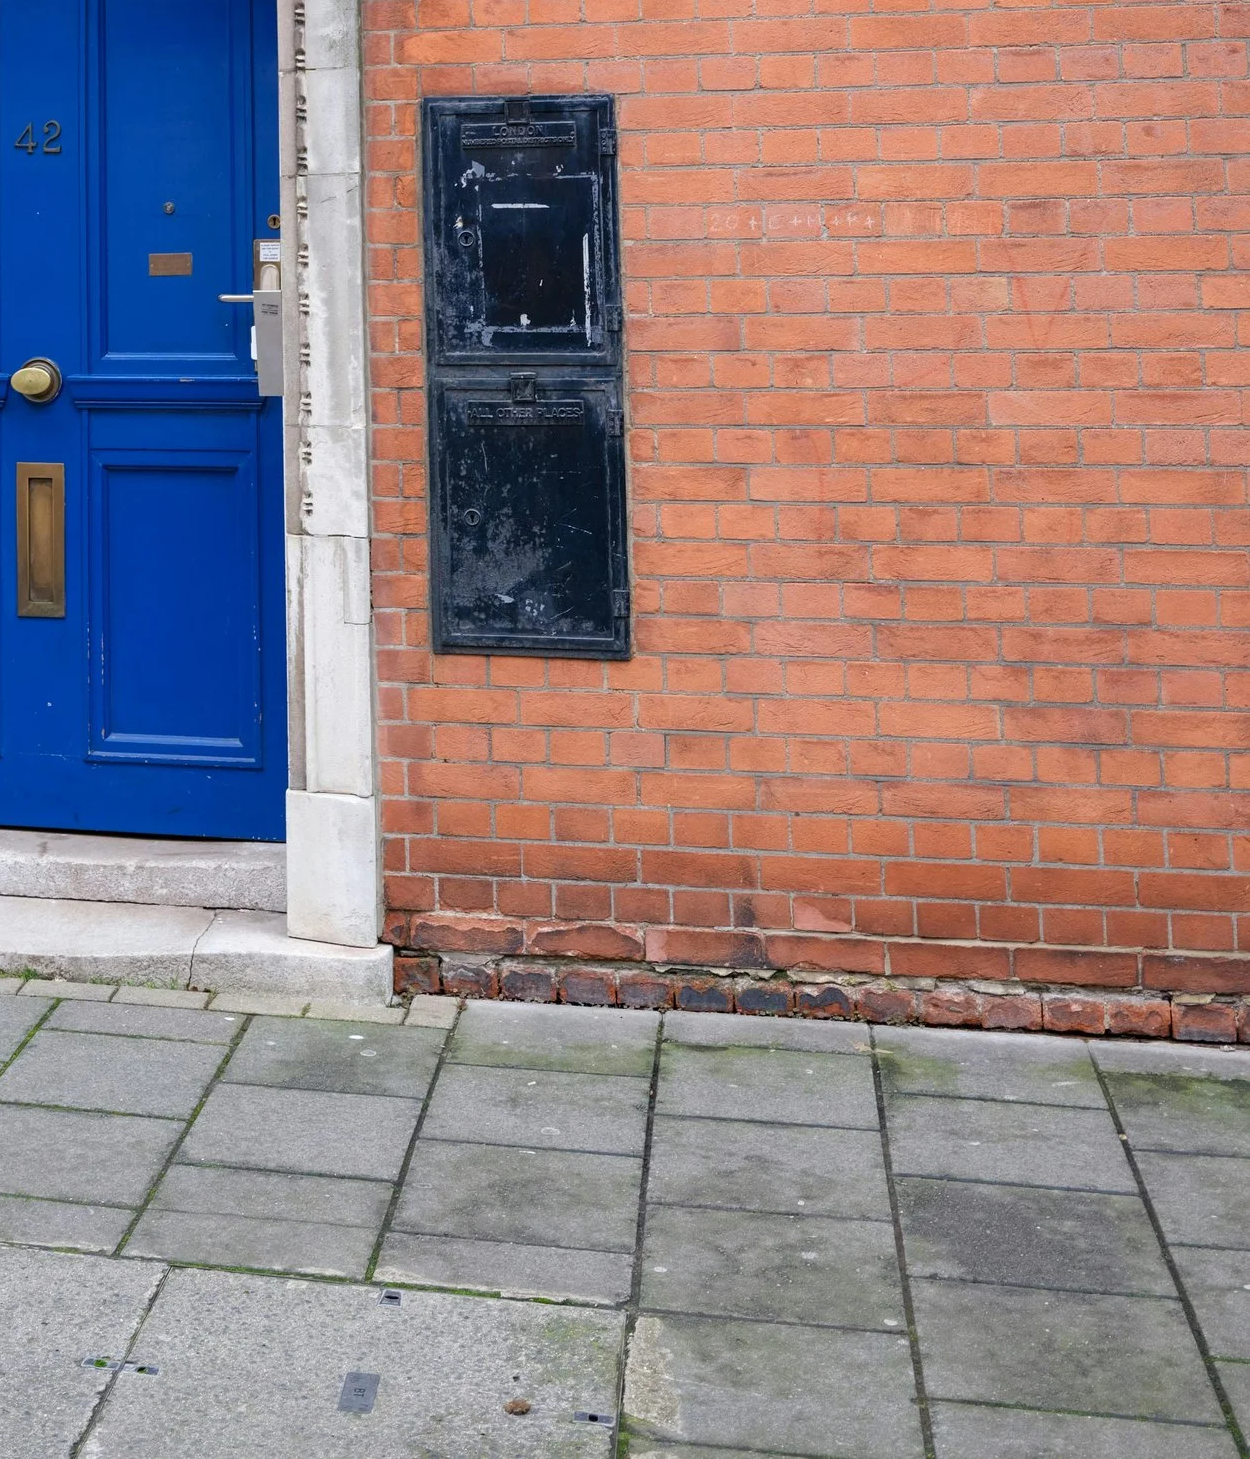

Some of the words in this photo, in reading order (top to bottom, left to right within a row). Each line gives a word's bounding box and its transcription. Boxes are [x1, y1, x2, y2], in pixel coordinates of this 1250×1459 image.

[492, 125, 544, 136] LONDON
[14, 119, 62, 154] 42
[470, 407, 493, 418] ALL
[496, 407, 534, 418] OTHER
[537, 407, 581, 418] PLACES
[353, 1388, 366, 1398] BT
